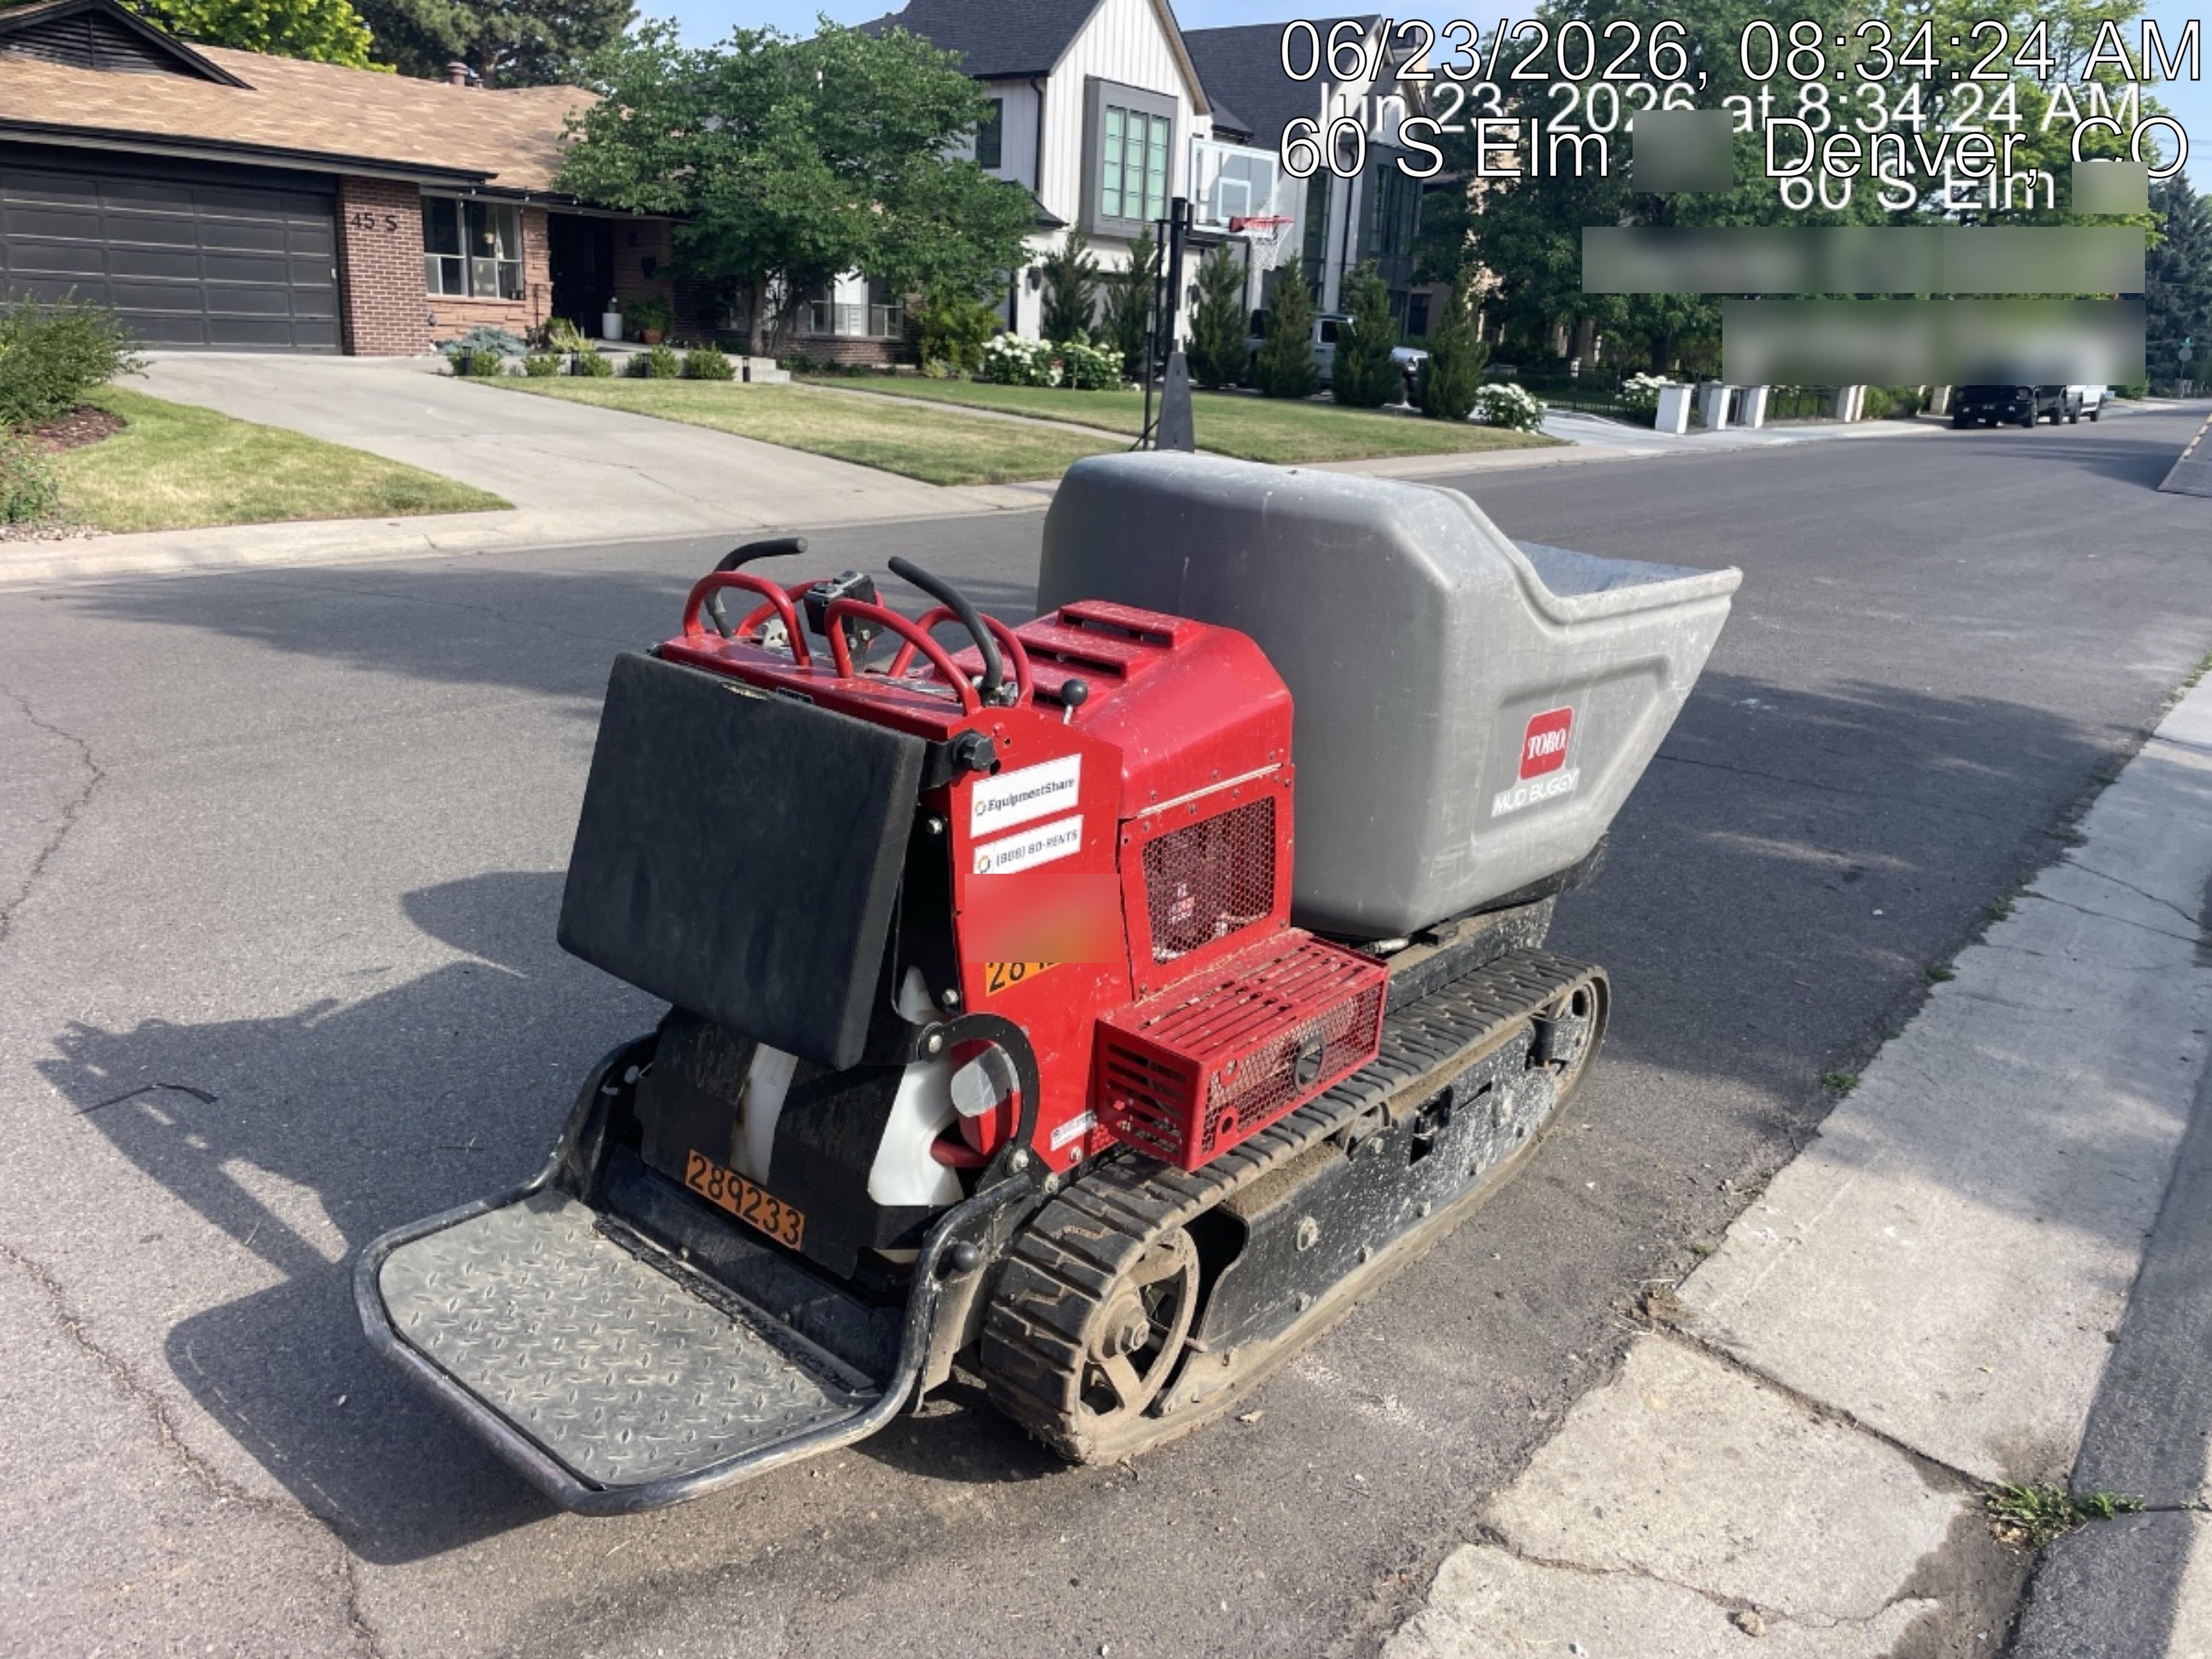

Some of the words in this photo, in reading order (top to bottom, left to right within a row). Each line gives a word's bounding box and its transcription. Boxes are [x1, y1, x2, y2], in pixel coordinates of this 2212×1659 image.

[350, 212, 375, 229] 45
[384, 215, 398, 231] S
[1528, 728, 1566, 760] TORO
[987, 779, 1075, 812] EquipmentShare
[1491, 788, 1527, 817] MUD
[1529, 769, 1580, 802] BUGGY
[688, 1155, 800, 1245] 289233
